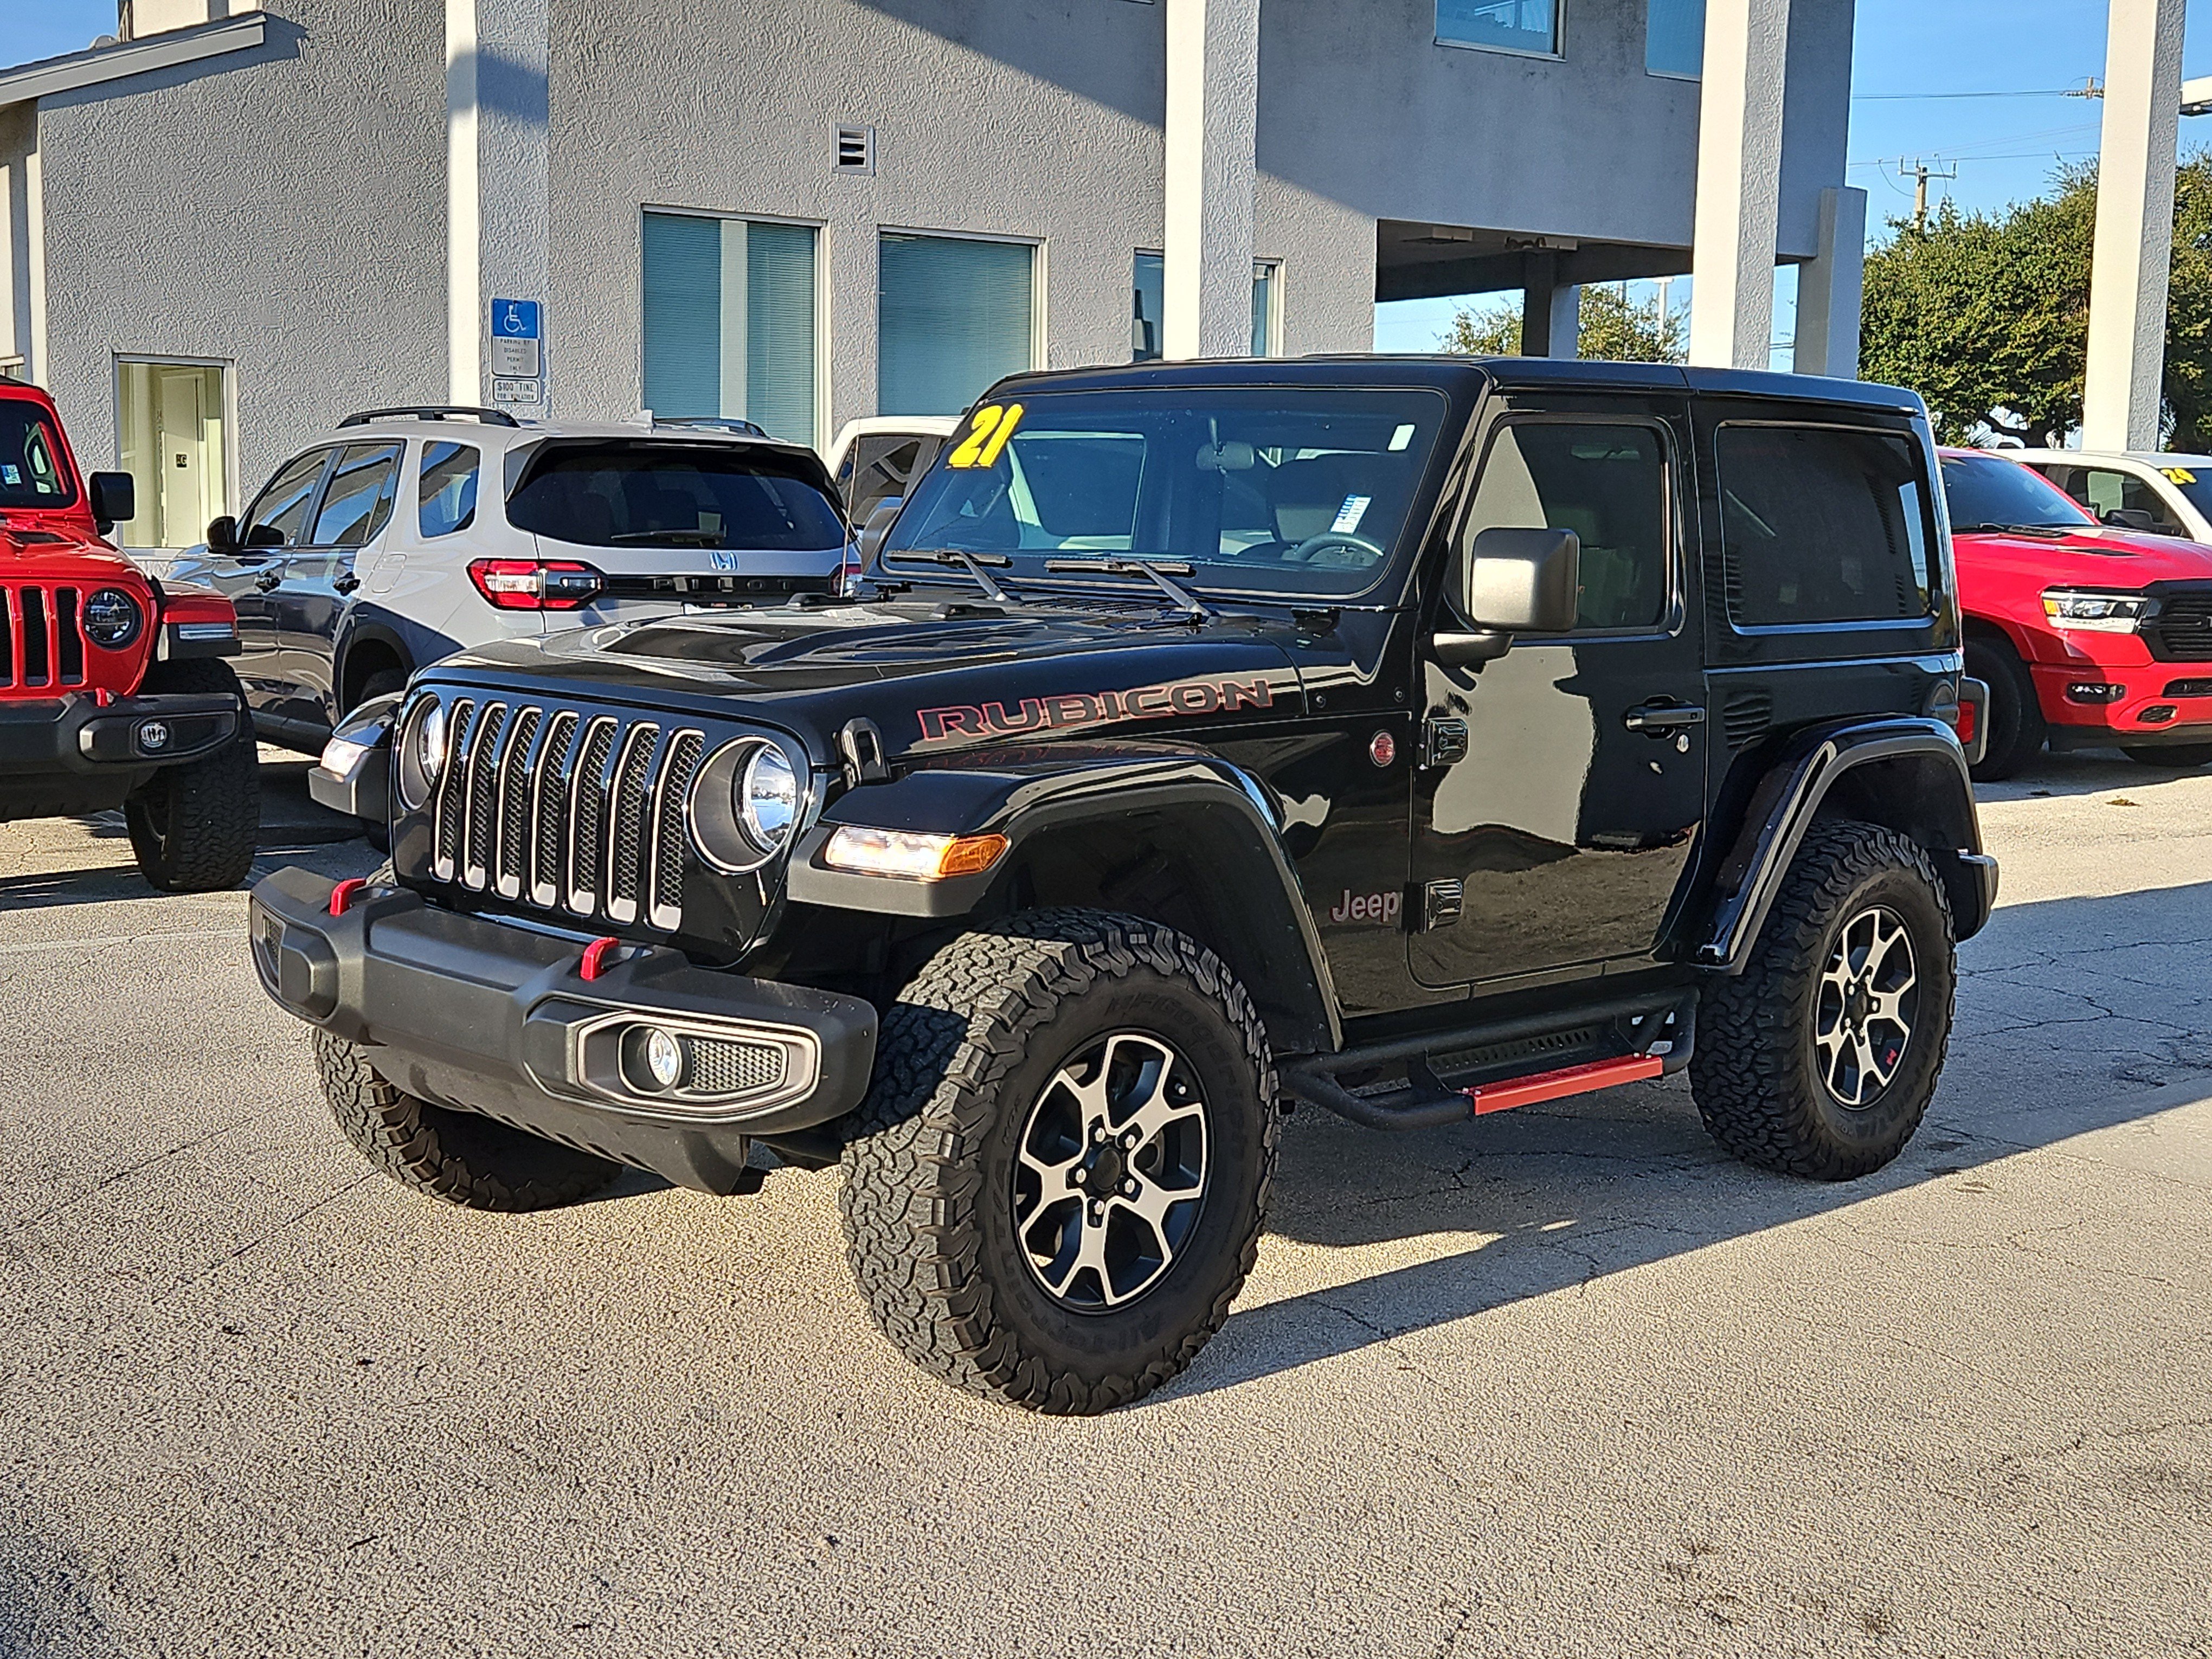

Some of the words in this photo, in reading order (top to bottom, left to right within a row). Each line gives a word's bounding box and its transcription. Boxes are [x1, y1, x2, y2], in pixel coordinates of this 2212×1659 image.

[497, 382, 513, 391] $100
[519, 383, 534, 392] FINE
[949, 404, 1023, 467] 21
[653, 578, 795, 591] PILOT
[917, 678, 1272, 741] RUBICON
[1330, 889, 1400, 922] Jeep
